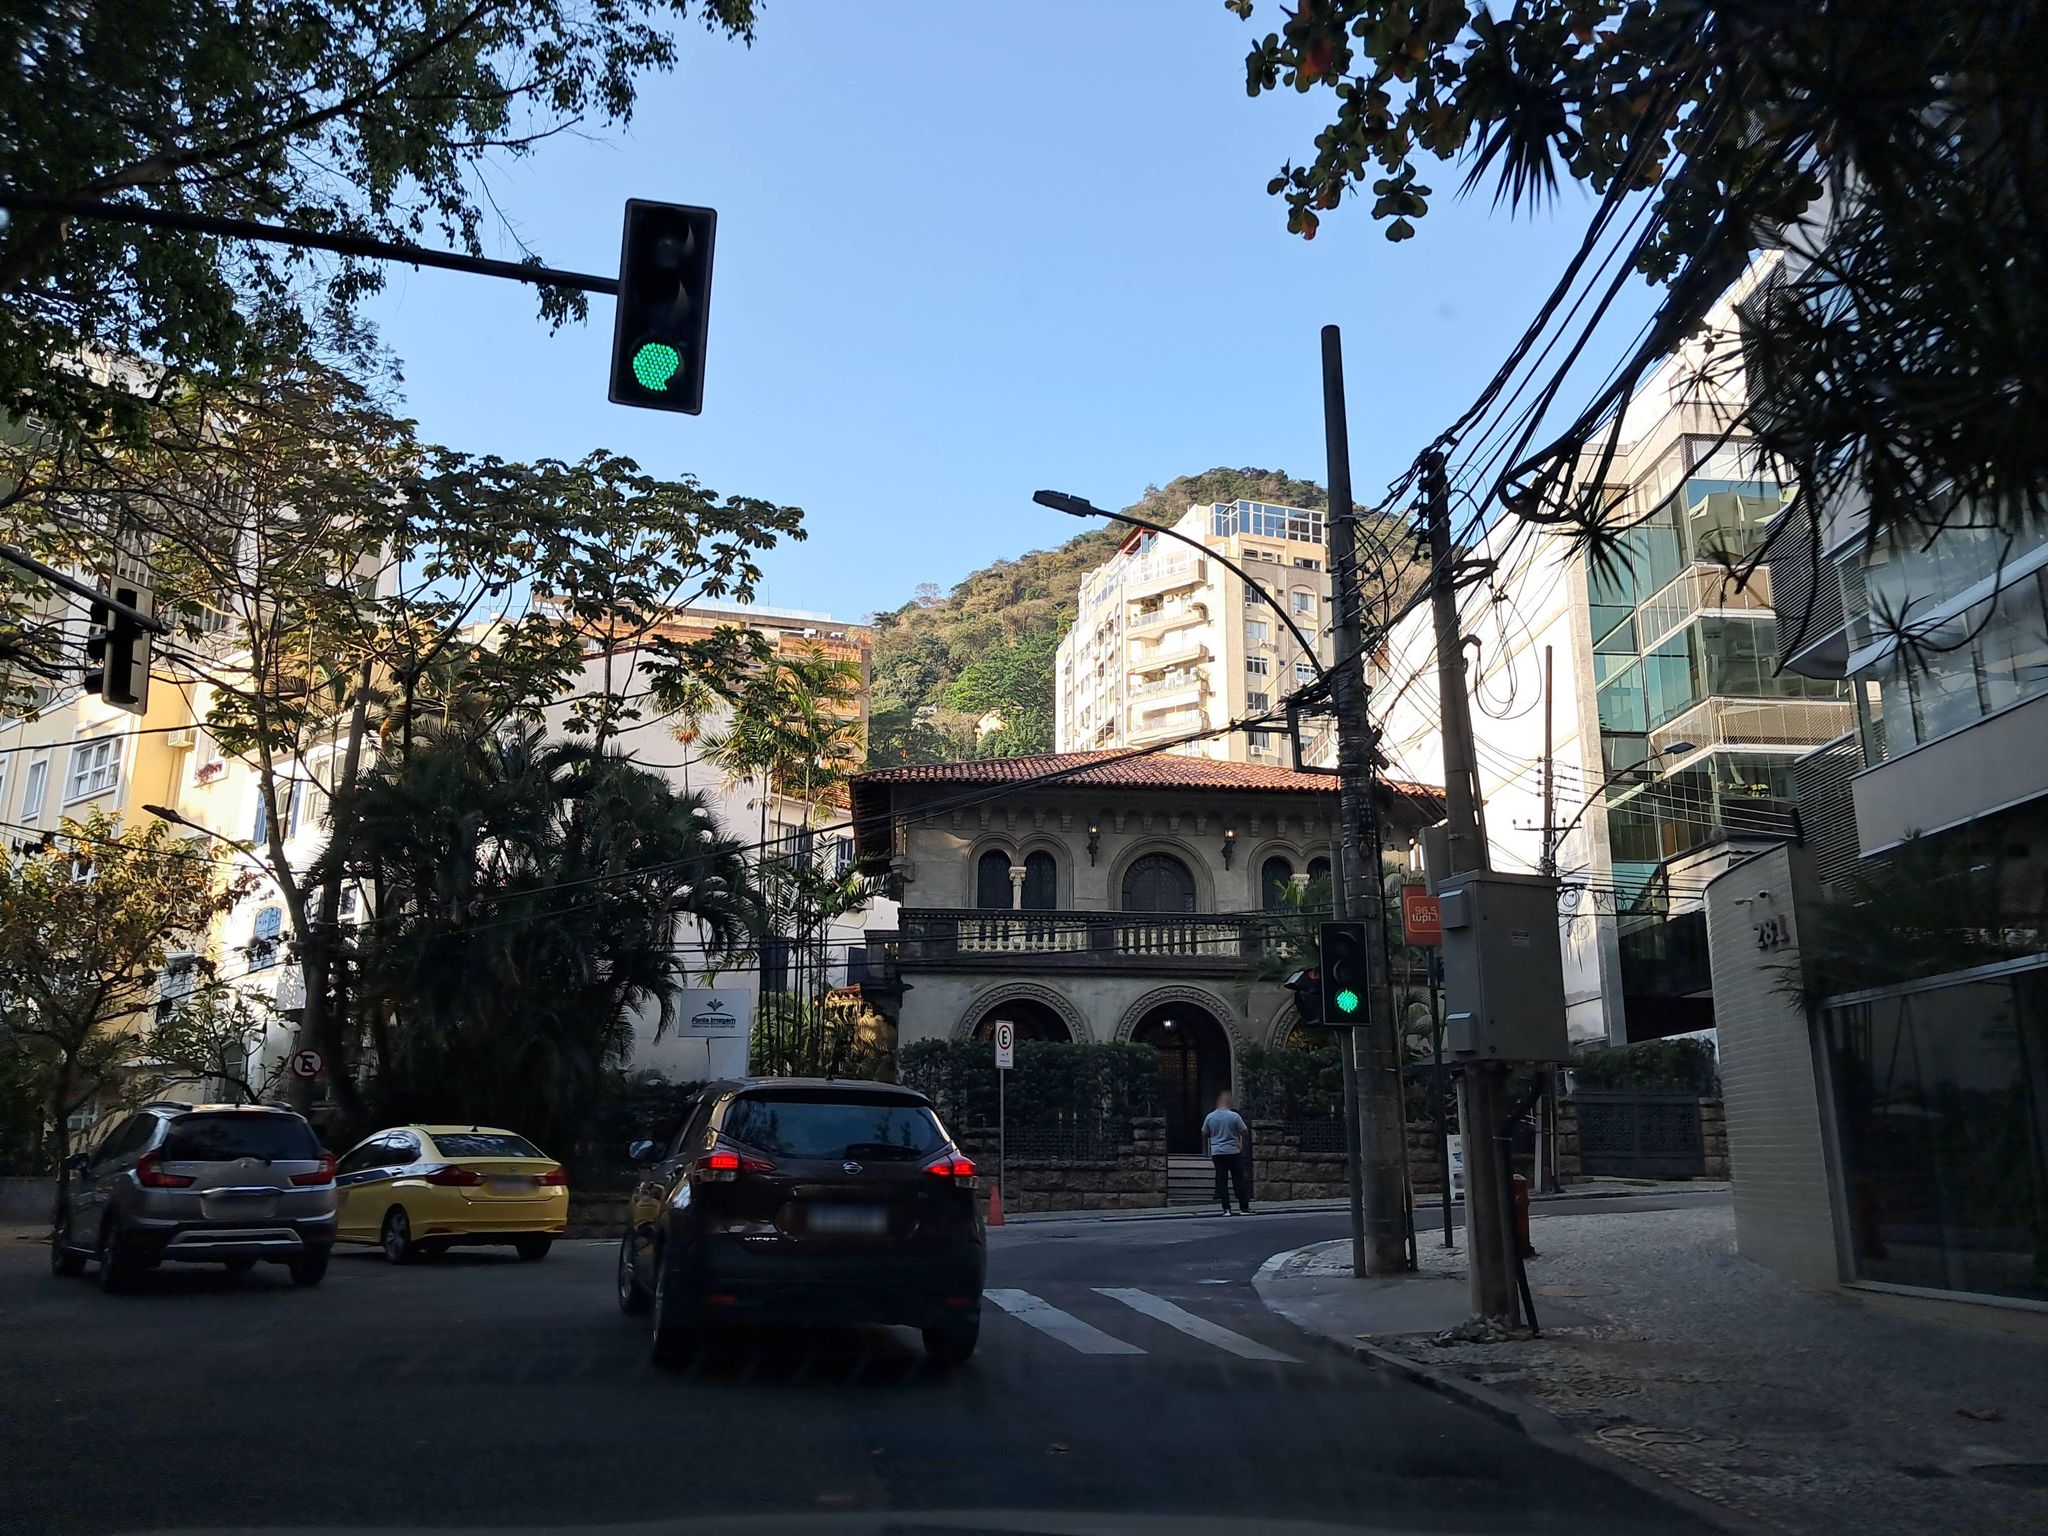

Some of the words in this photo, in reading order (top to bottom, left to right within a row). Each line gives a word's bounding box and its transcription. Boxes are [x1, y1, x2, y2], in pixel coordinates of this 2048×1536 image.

[1414, 905, 1437, 915] 96.5
[1412, 913, 1440, 923] tupi.f
[300, 1055, 315, 1073] E
